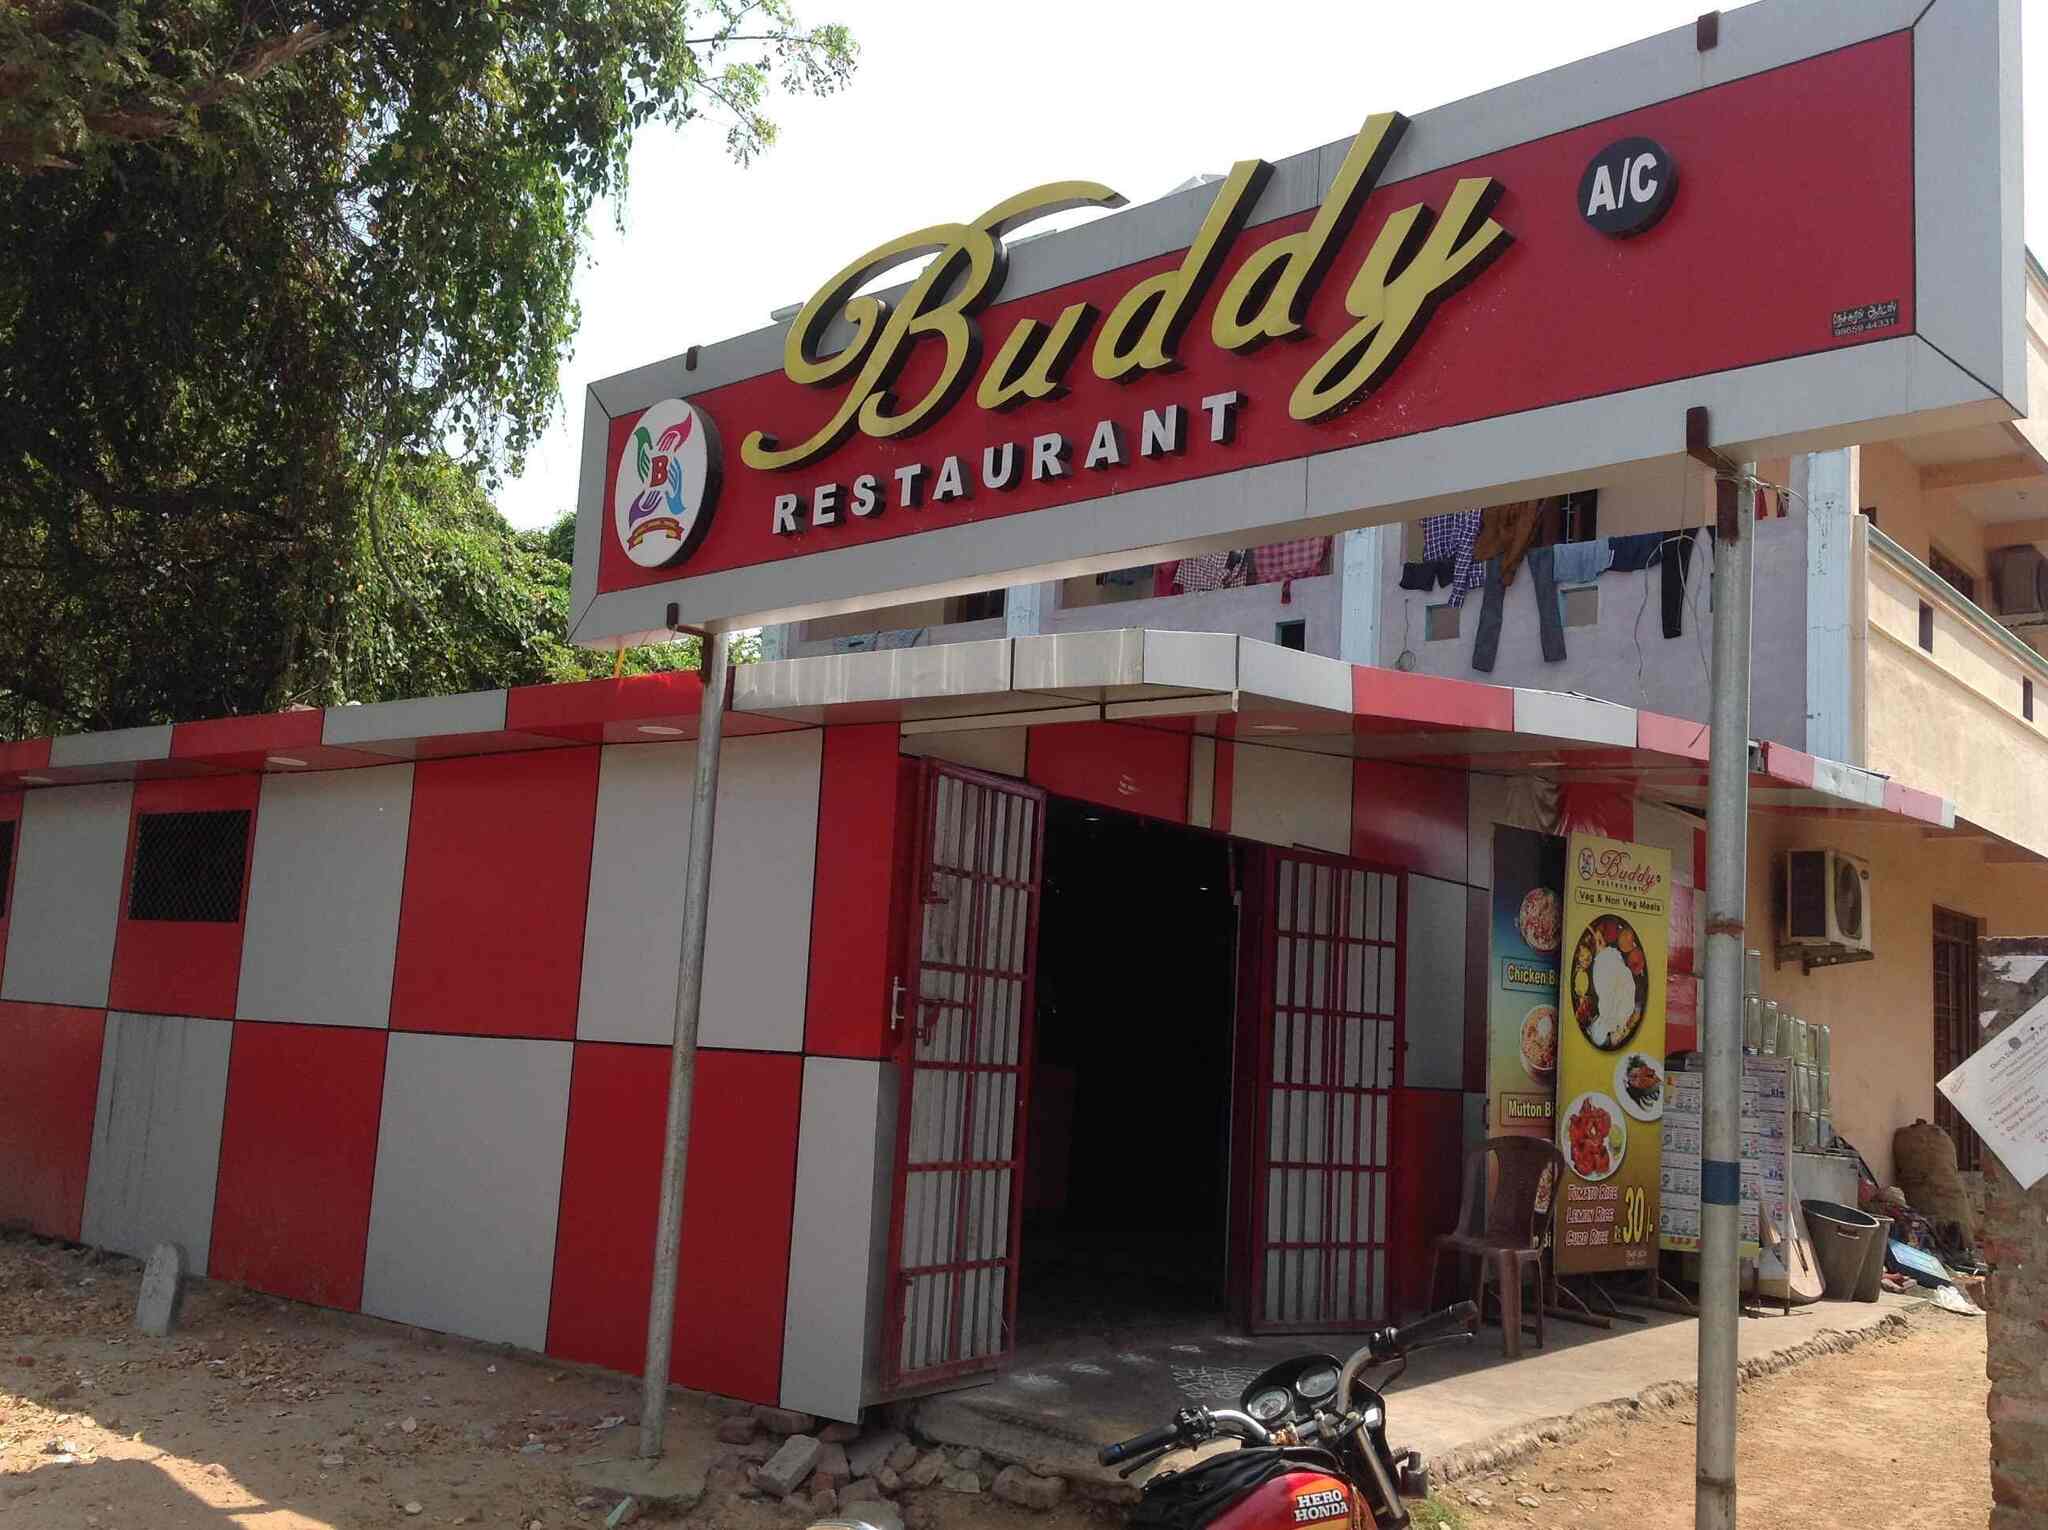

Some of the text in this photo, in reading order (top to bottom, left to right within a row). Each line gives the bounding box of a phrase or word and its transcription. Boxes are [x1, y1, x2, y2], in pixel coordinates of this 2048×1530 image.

[1586, 151, 1659, 217] A/C
[740, 110, 1510, 470] Buddy
[649, 454, 669, 488] B
[771, 390, 1240, 537] RESTAURANT
[1595, 849, 1656, 896] Buddy
[1579, 889, 1594, 904] Veg
[1605, 895, 1620, 905] Non
[1622, 897, 1637, 910] Veg
[1508, 964, 1546, 985] Chicken
[1508, 1100, 1542, 1118] Mutton
[1294, 1502, 1349, 1522] HONDA
[1296, 1489, 1342, 1508] HERO
